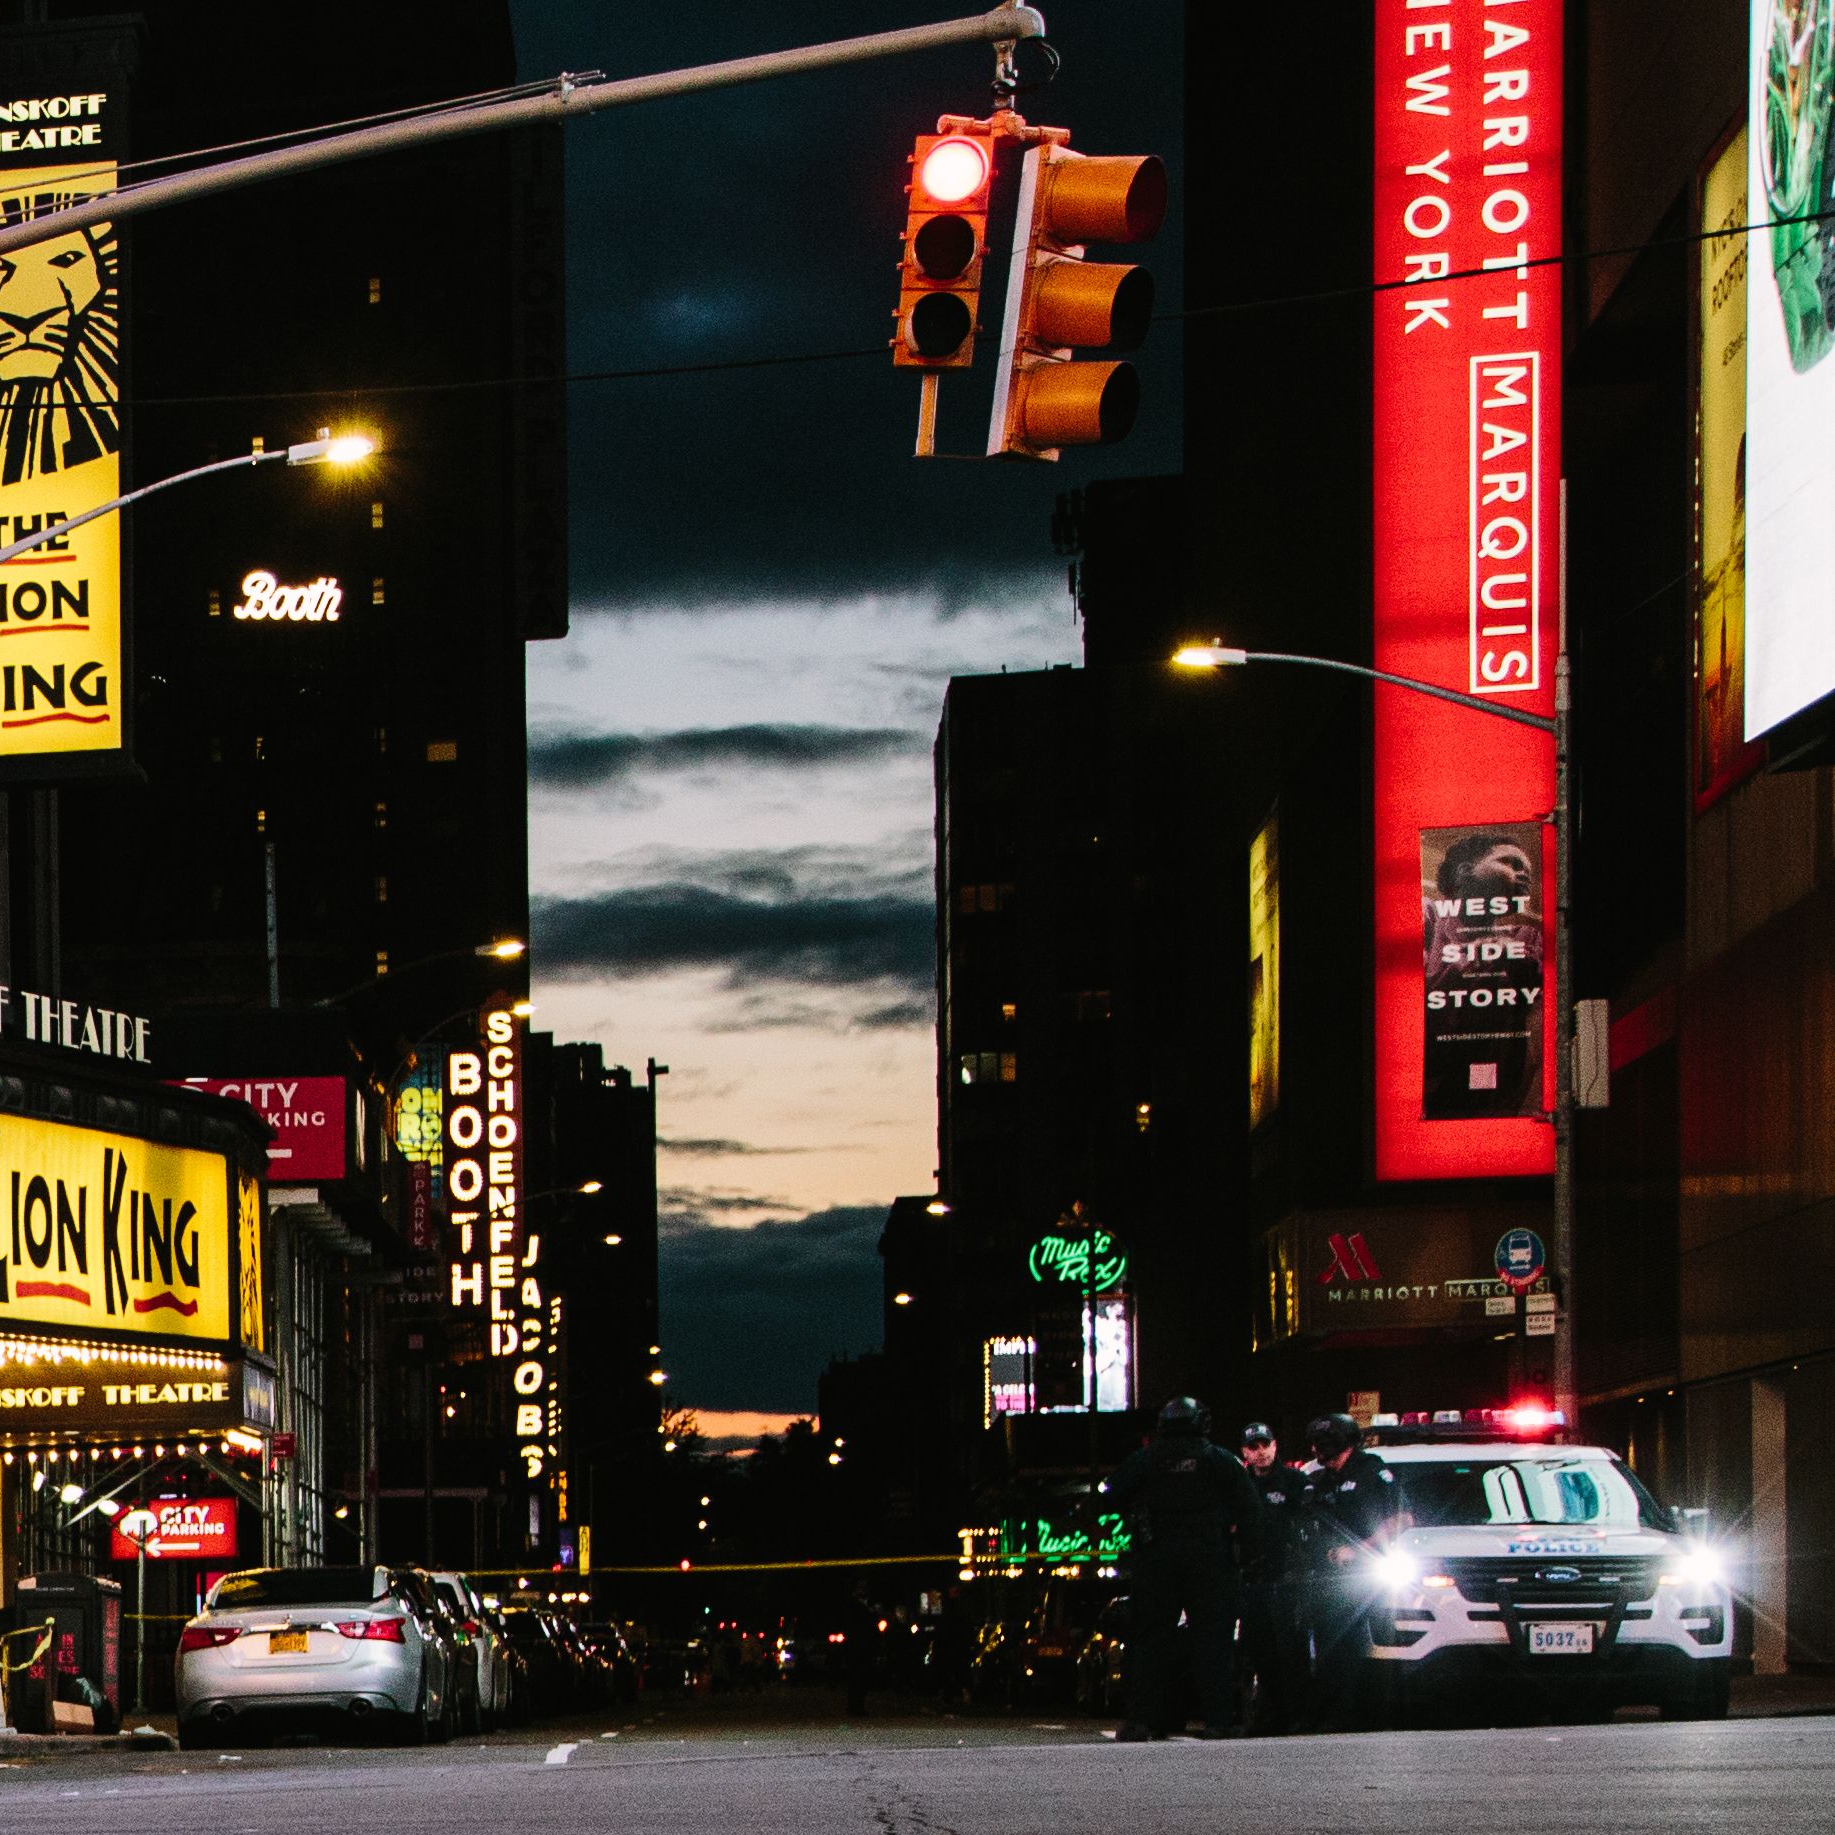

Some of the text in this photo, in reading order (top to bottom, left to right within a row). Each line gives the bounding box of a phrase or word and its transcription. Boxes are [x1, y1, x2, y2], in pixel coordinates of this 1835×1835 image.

[1403, 0, 1451, 335] EW YORK
[1478, 364, 1528, 684] MARQUIS
[234, 570, 343, 622] Booth
[1434, 895, 1532, 918] WEST
[1441, 941, 1527, 963] SIDE
[1426, 987, 1541, 1010] STORY
[20, 990, 152, 1065] THEATRE
[266, 1112, 327, 1128] KING
[449, 1052, 484, 1307] BOOTH
[487, 1009, 520, 1357] SCHOENFELD
[103, 1147, 200, 1318] KING
[1040, 1230, 1111, 1266] Music
[1328, 1285, 1439, 1302] MARRIOTT
[103, 1382, 230, 1407] THEATRE
[159, 1505, 210, 1524] CITY
[160, 1522, 225, 1536] PARKING
[1508, 1542, 1600, 1554] POLICE
